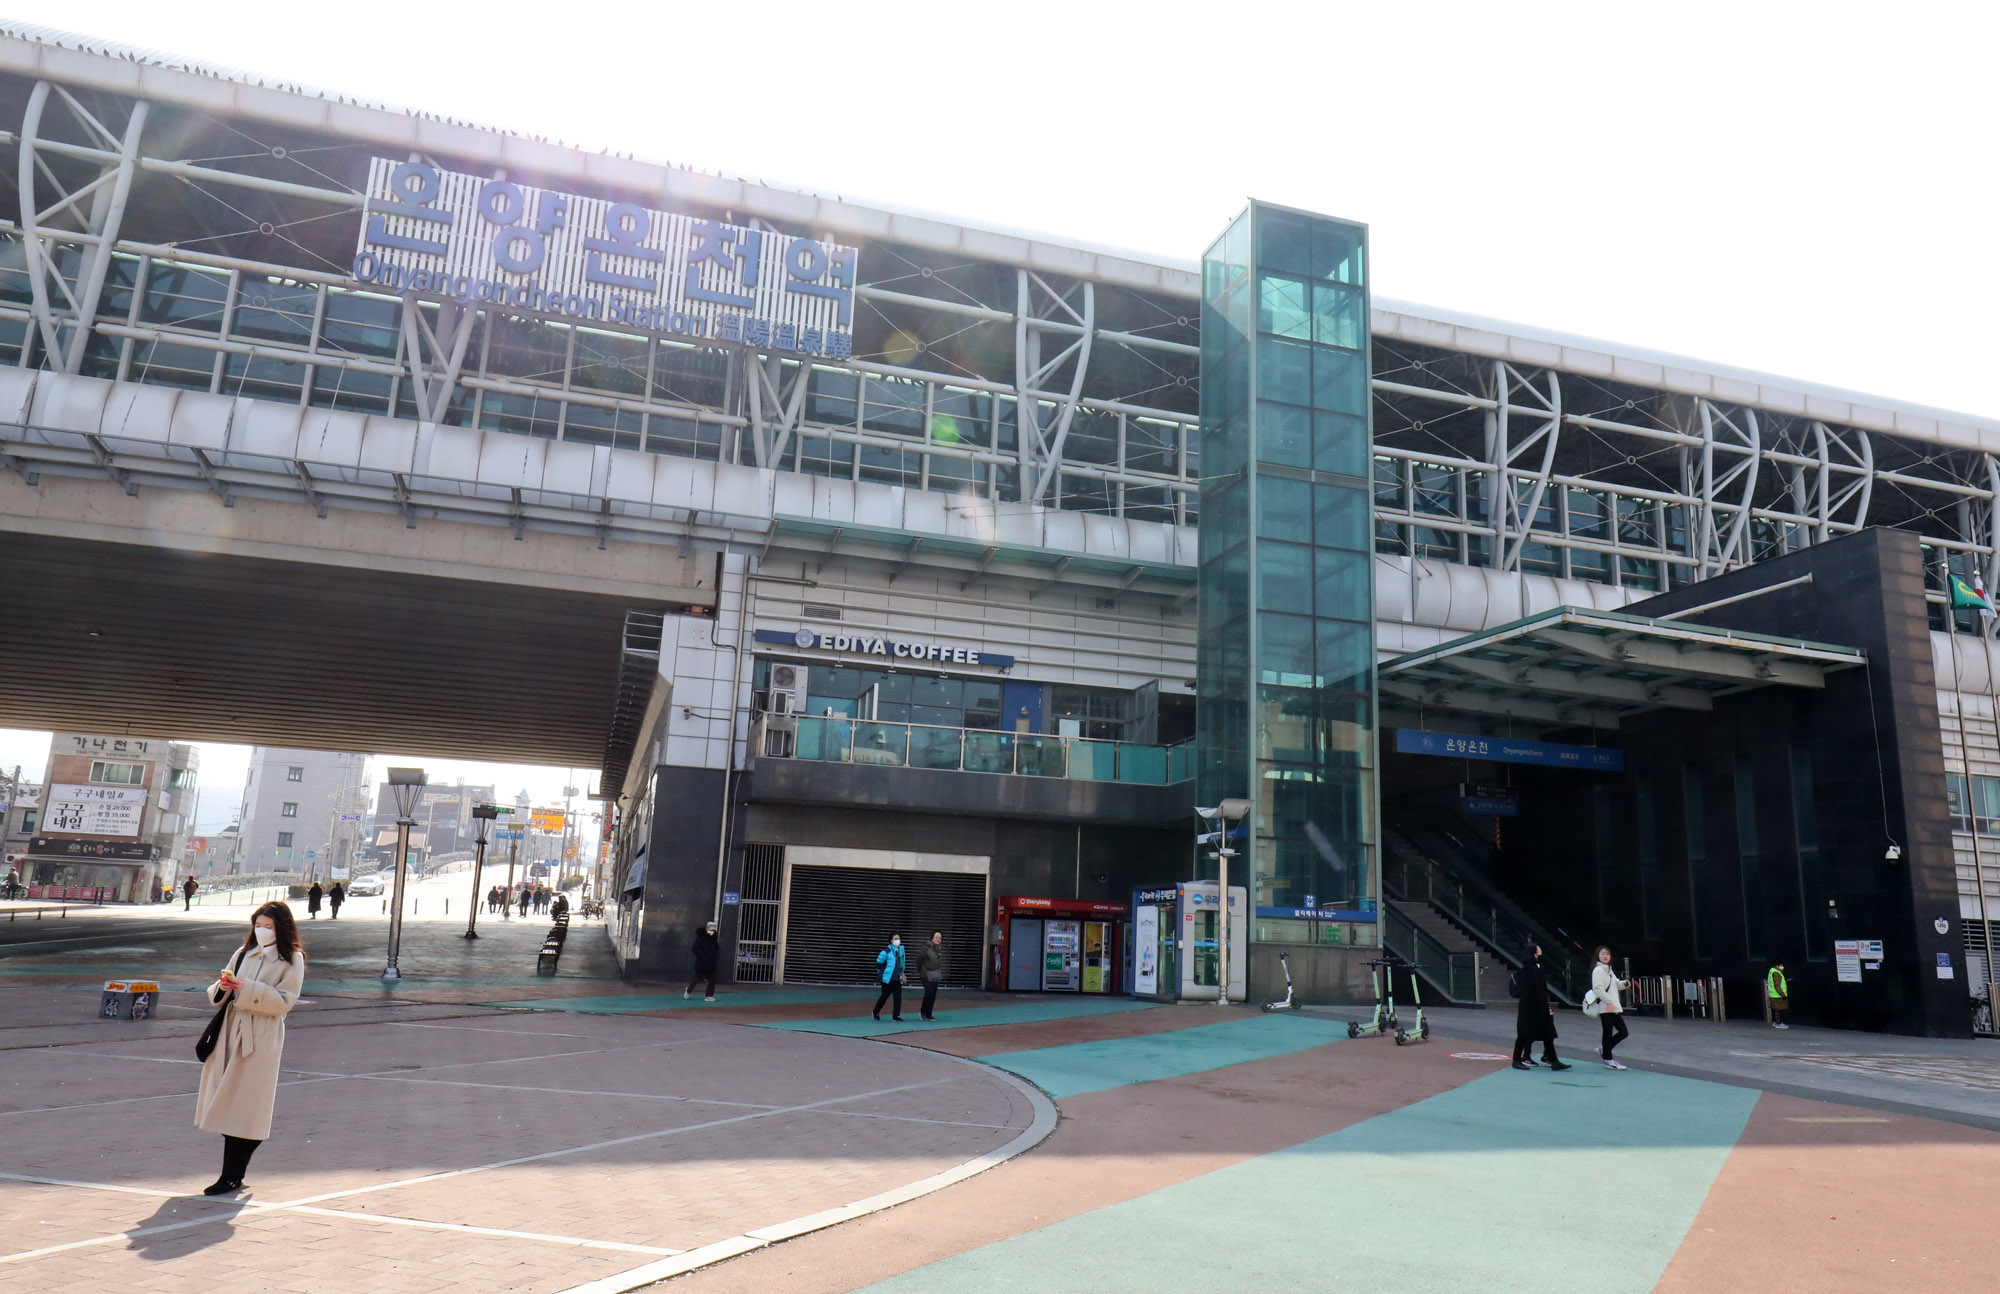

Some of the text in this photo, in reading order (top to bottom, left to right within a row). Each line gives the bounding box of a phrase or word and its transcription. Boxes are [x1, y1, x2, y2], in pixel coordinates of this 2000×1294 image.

[365, 162, 855, 326] 온양온천역
[352, 251, 706, 337] Onyangoncheon Station
[819, 633, 979, 665] EDIYA COFFEE
[1446, 738, 1488, 755] 온양온천
